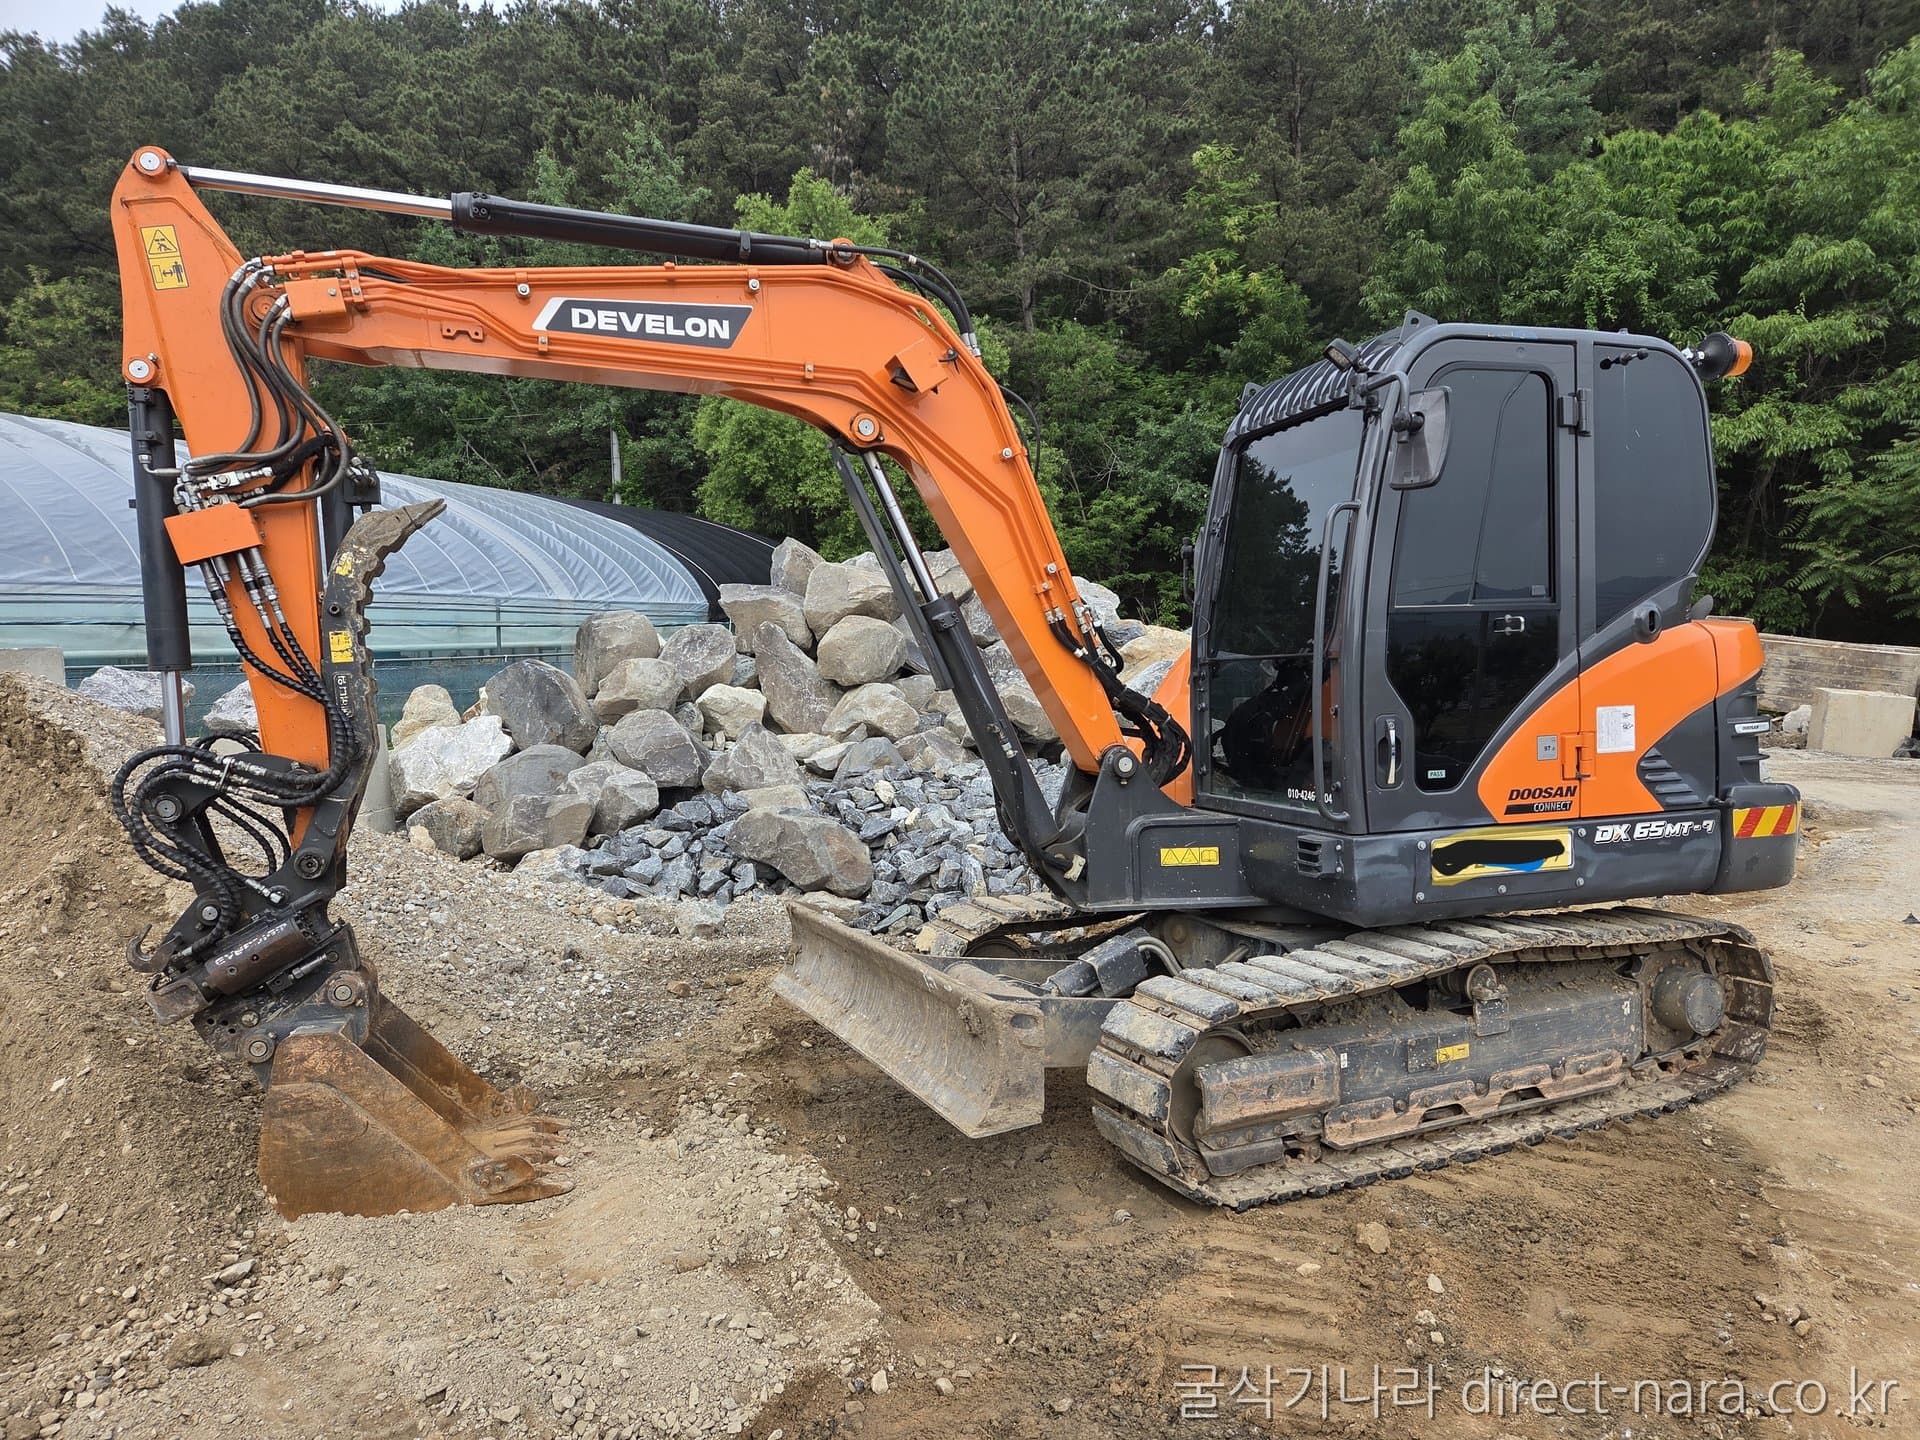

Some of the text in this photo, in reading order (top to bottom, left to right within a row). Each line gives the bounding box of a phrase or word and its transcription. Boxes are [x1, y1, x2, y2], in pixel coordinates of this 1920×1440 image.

[571, 308, 729, 339] DEVELON
[1509, 786, 1577, 800] DOOSAN
[1533, 801, 1571, 812] CONNECT
[1594, 824, 1631, 844] DX
